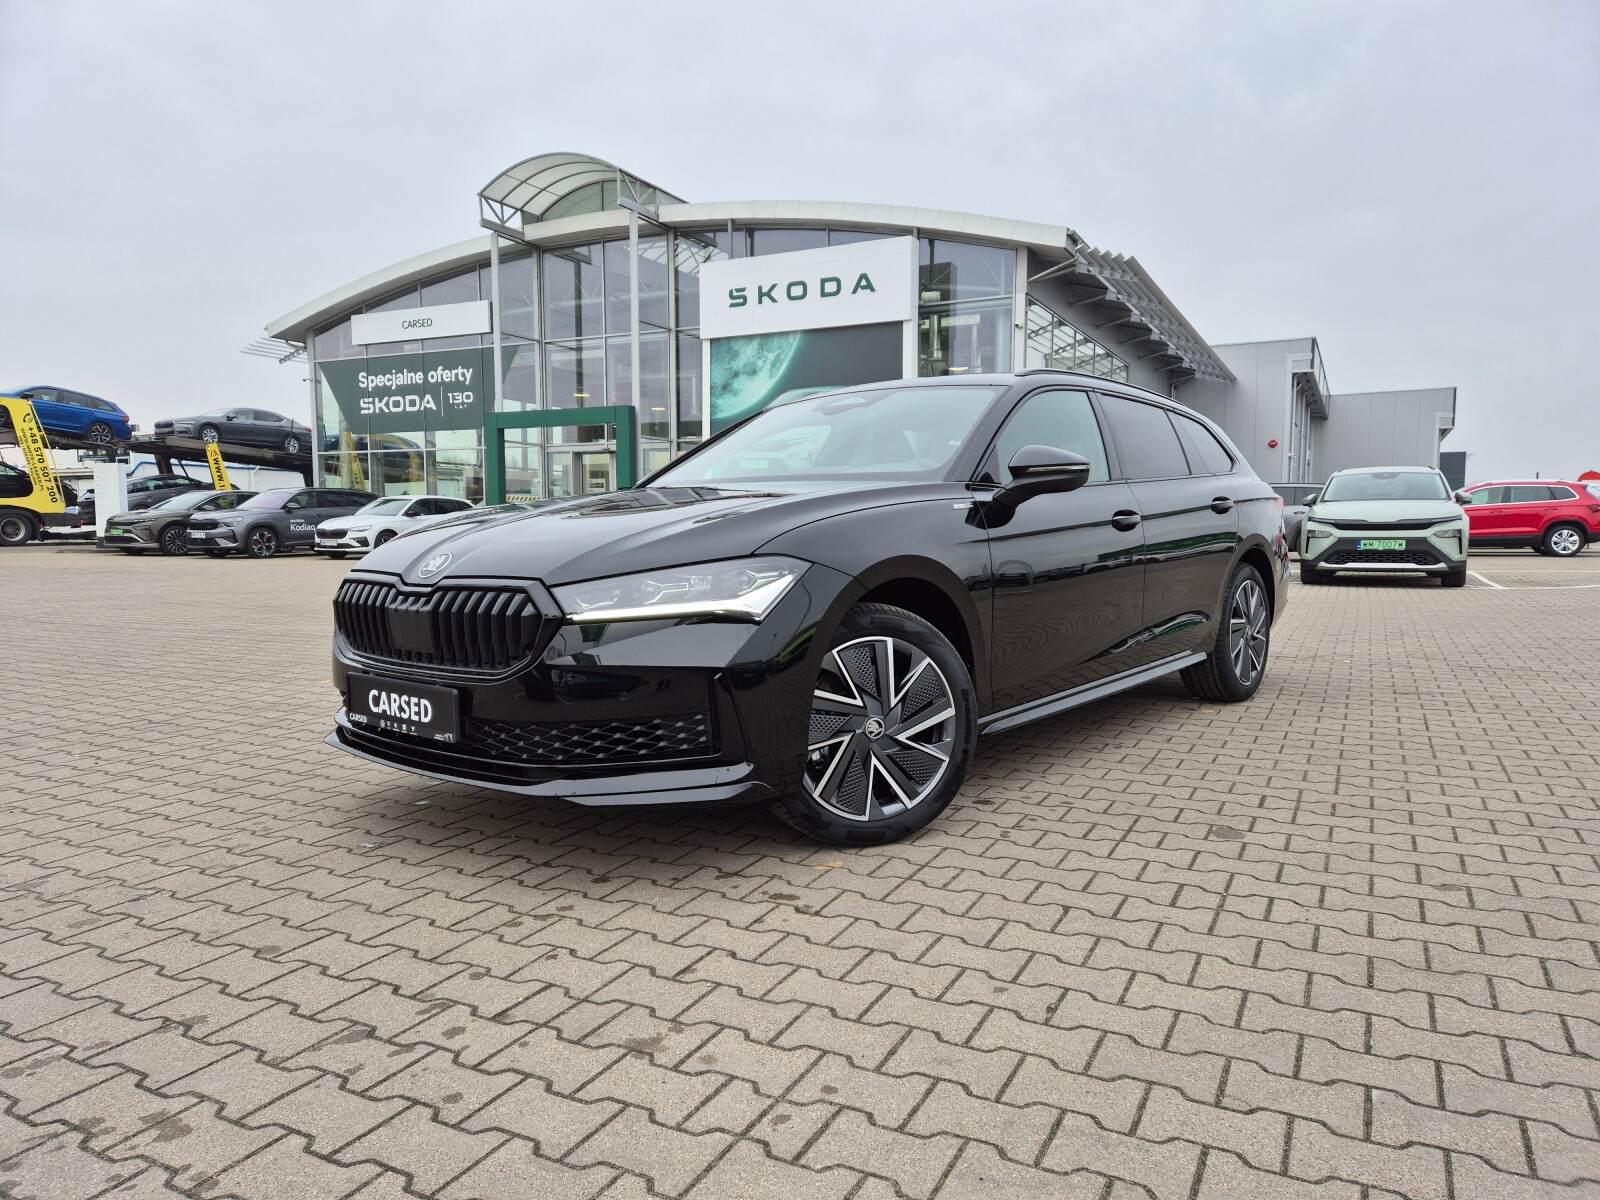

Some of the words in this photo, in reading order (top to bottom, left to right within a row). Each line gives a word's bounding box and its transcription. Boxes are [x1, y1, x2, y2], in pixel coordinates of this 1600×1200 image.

[401, 317, 433, 330] CARSED
[358, 369, 424, 391] Specjalne
[427, 365, 473, 386] oferty
[447, 391, 474, 405] 130
[28, 426, 39, 444] +48
[33, 446, 45, 464] 570
[40, 465, 52, 483] 507
[47, 485, 58, 503] 200
[290, 523, 315, 532] Kodiaq
[368, 689, 433, 723] CARSED
